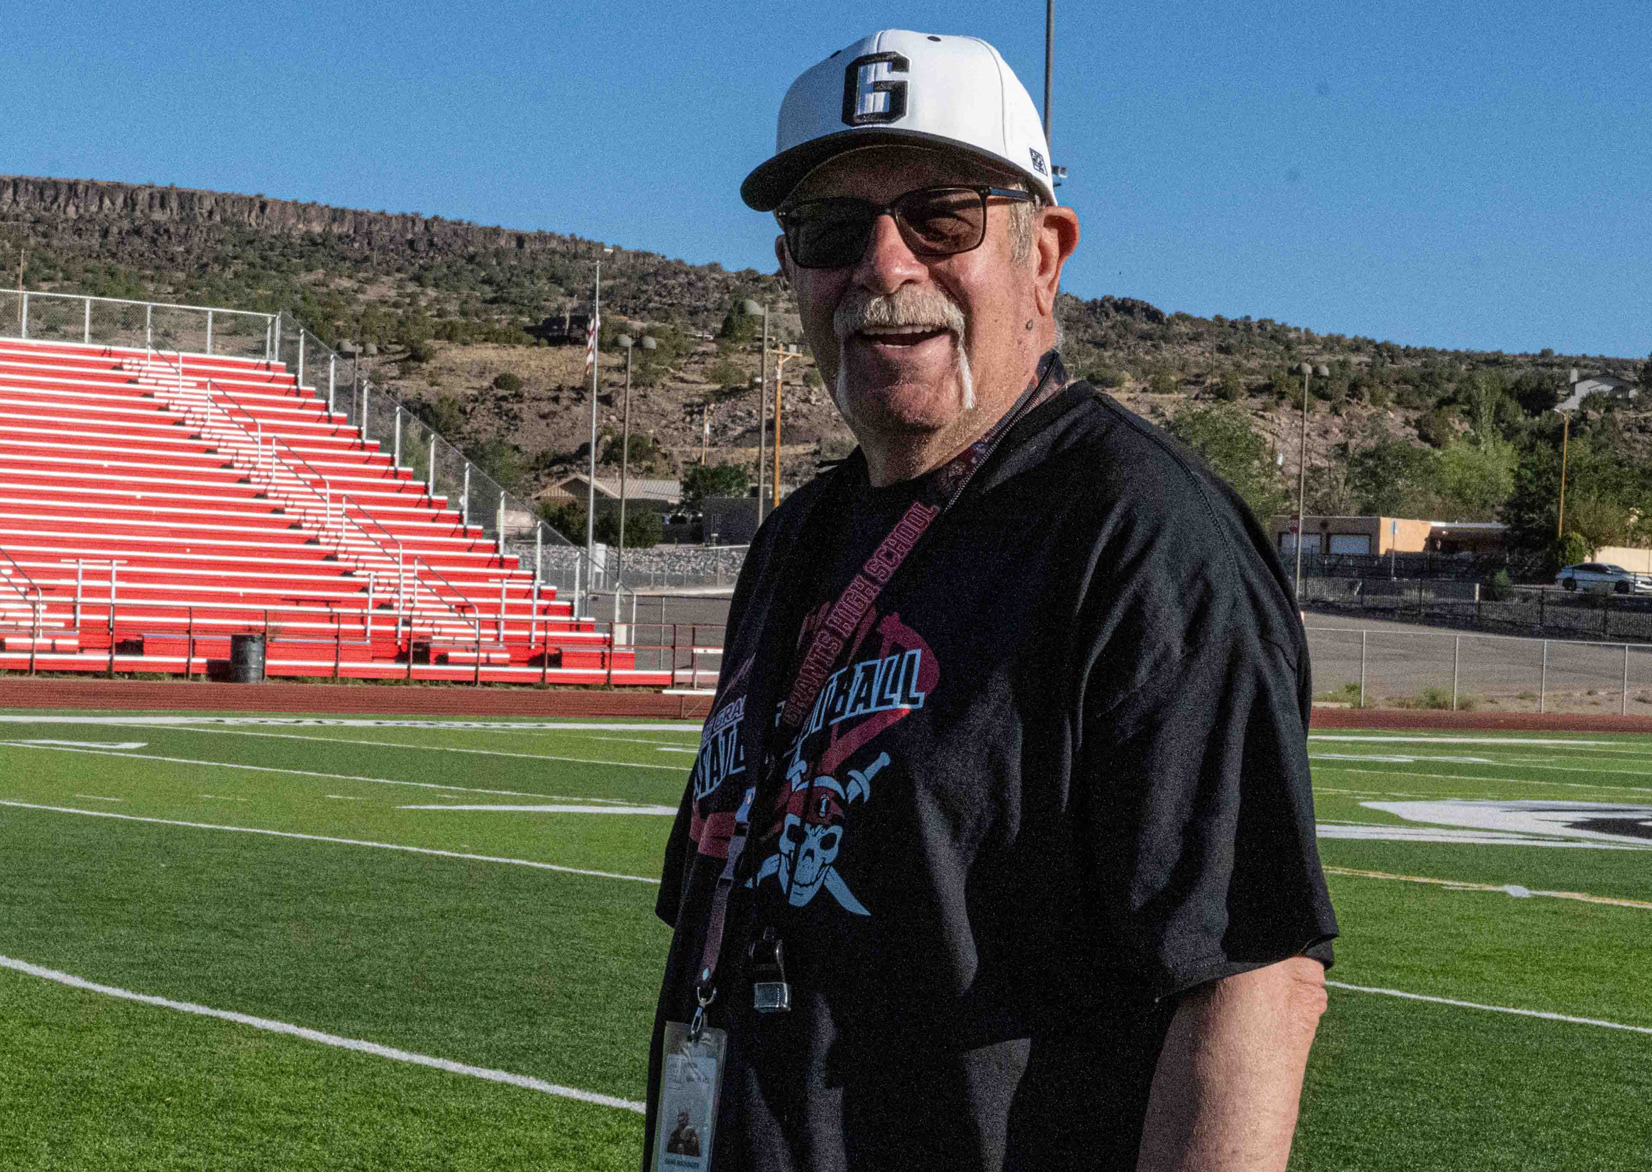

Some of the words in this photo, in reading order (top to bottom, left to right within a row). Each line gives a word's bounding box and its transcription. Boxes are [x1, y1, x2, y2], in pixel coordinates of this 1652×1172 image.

[782, 630, 844, 727] GRANTS
[826, 574, 881, 638] HIGH
[862, 500, 941, 584] SCHOOL
